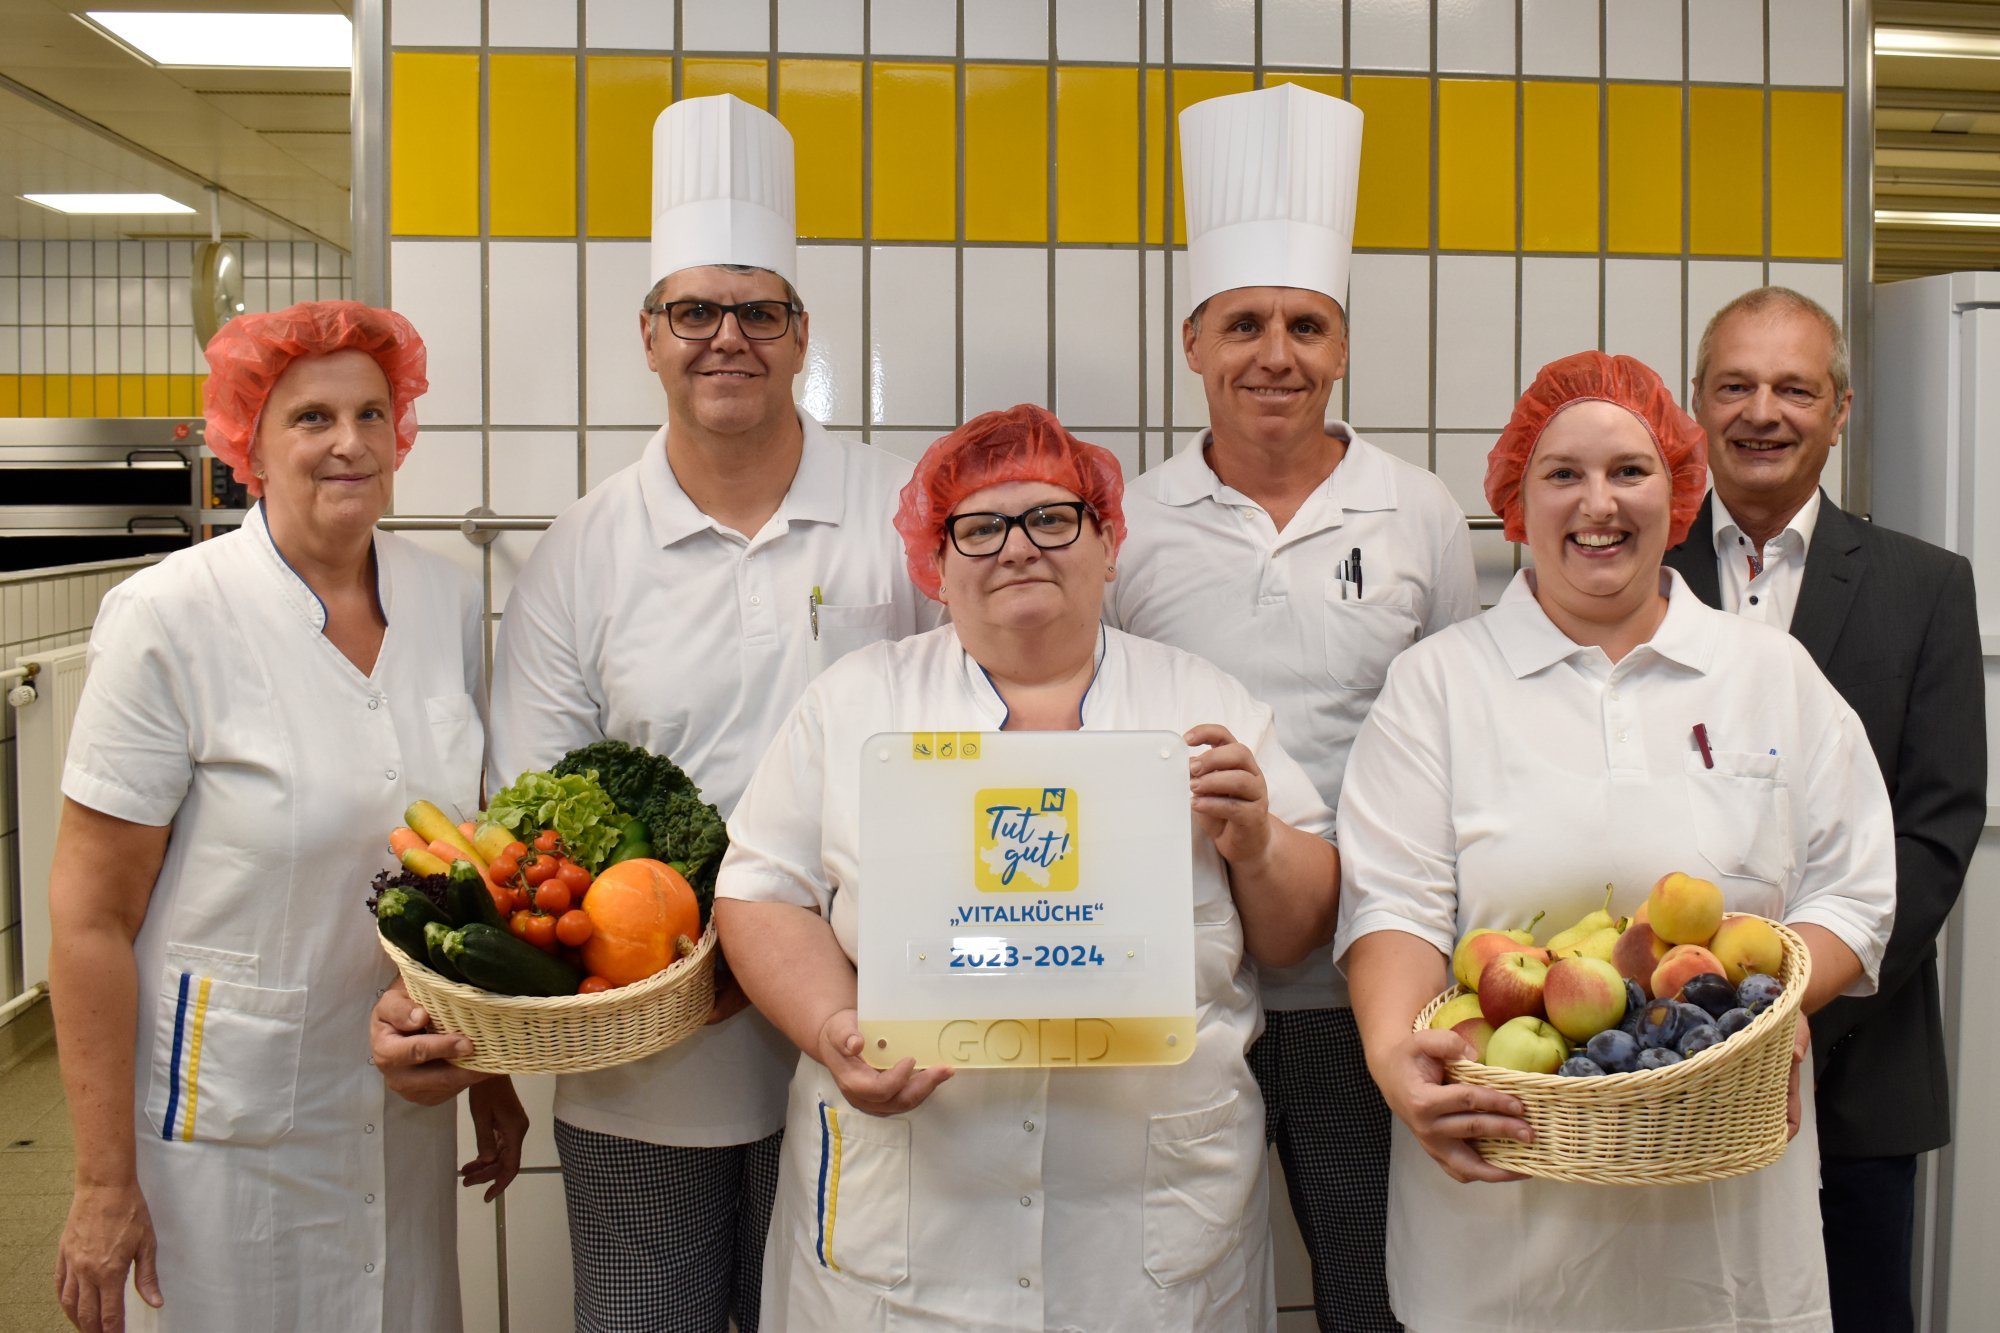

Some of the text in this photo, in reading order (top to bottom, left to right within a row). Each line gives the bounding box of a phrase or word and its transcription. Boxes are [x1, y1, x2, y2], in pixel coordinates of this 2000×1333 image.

[986, 805, 1040, 843] Tut
[1001, 830, 1070, 885] gut!
[950, 900, 1104, 927] „VITALKÜCHE“
[950, 945, 1104, 968] 2023-2024
[937, 1018, 1117, 1067] GOLD
